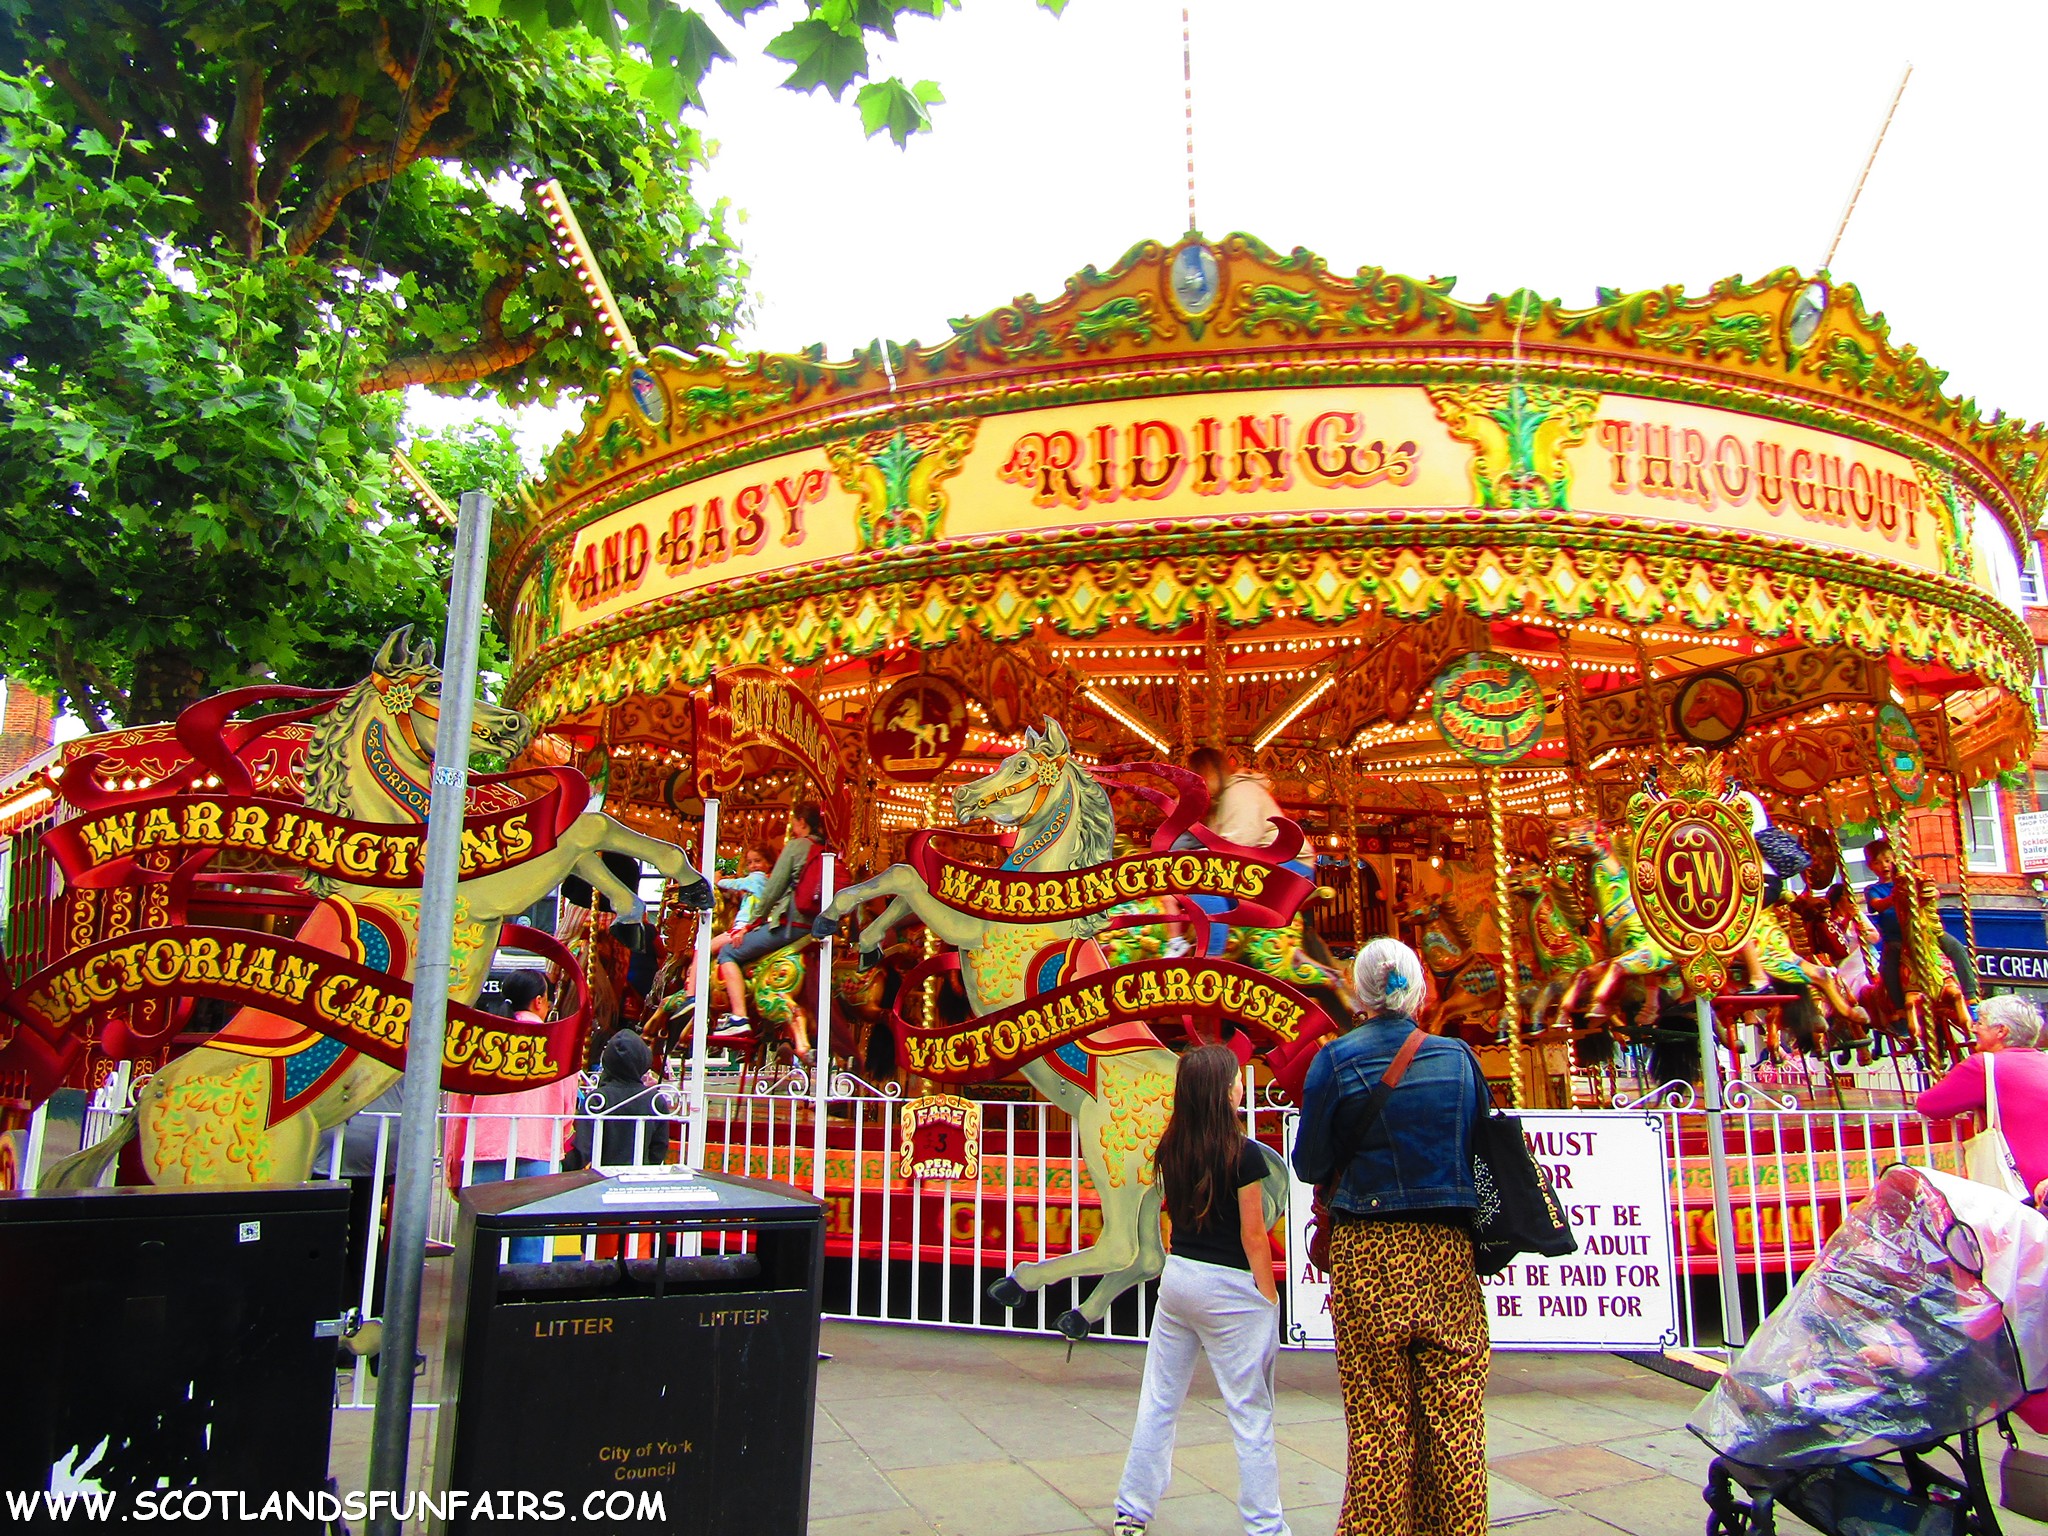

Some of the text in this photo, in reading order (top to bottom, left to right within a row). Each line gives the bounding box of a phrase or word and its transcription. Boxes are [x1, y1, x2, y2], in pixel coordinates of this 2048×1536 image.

[997, 411, 1420, 509] RIDING
[1598, 419, 1921, 549] THROUGHOUT
[569, 468, 829, 612] AND EASY
[730, 678, 839, 796] ENTRANCE
[79, 801, 533, 877] WARRINGTNS
[1012, 811, 1067, 865] GORDON
[939, 856, 1272, 914] WARRINGTONS
[1975, 954, 1997, 976] CE
[27, 938, 558, 1081] VICTORIAN CARUSEL
[905, 967, 1306, 1072] VICTORIAN CAROUSEL
[917, 1106, 964, 1127] FARE
[913, 1162, 964, 1179] PERSON
[925, 1159, 952, 1169] PER
[1614, 1205, 1641, 1226] BE
[1584, 1235, 1651, 1255] ADULT
[1527, 1266, 1551, 1286] BE
[1560, 1265, 1607, 1286] PAID
[1617, 1265, 1660, 1286] FOR
[1497, 1295, 1643, 1317] BE PAID FOR
[535, 1318, 614, 1338] LITTER
[699, 1309, 769, 1328] LITTER
[599, 1446, 630, 1463] City
[636, 1443, 652, 1457] of
[614, 1462, 676, 1480] Council
